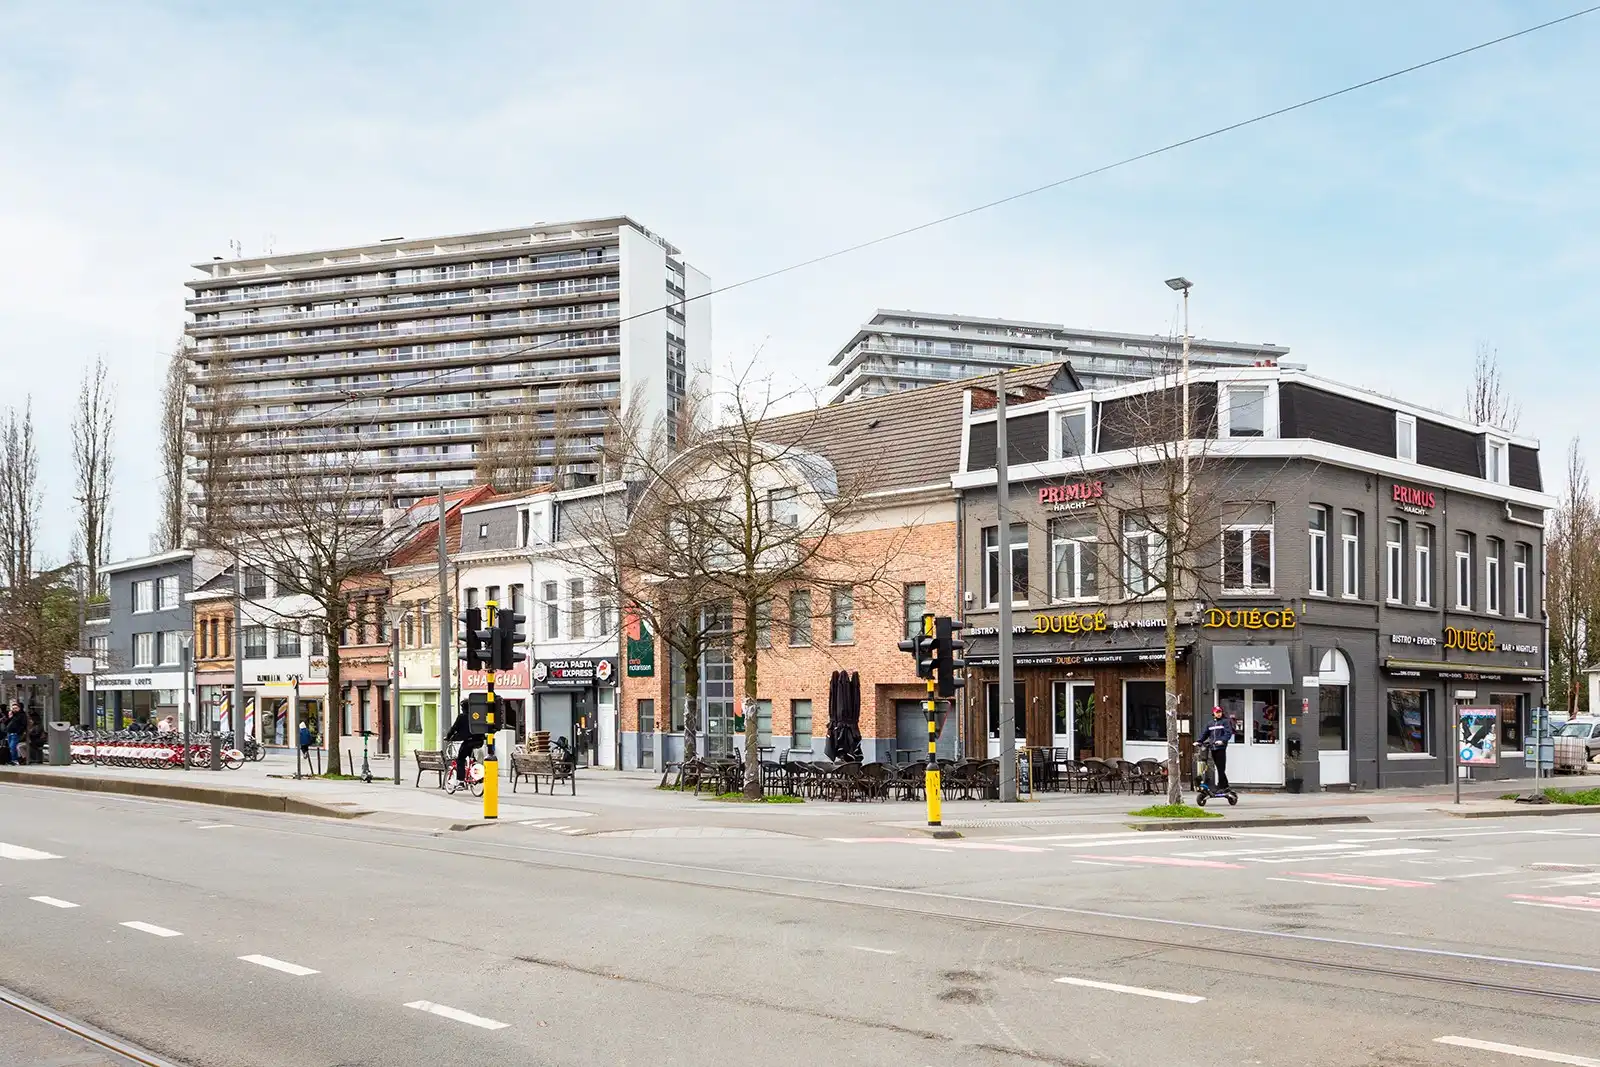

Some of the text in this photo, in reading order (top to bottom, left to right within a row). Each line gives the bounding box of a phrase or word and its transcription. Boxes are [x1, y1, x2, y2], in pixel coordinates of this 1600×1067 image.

[1038, 481, 1103, 504] PRIMUS
[1393, 484, 1436, 508] PRIMUS
[1054, 501, 1087, 511] HAACHT
[1032, 610, 1106, 634] DULÉGÉ
[1113, 619, 1177, 629] BAR NIGHTLI
[1203, 608, 1296, 629] DULÉGÉ
[1392, 634, 1437, 646] BISTRO EVENTS
[1443, 626, 1496, 651] DULÉGÉ
[1502, 643, 1539, 654] BAR NIGHTLIFE
[570, 660, 593, 668] PASTA
[562, 669, 593, 678] EXPRESS
[467, 674, 522, 686] SHAGHAI
